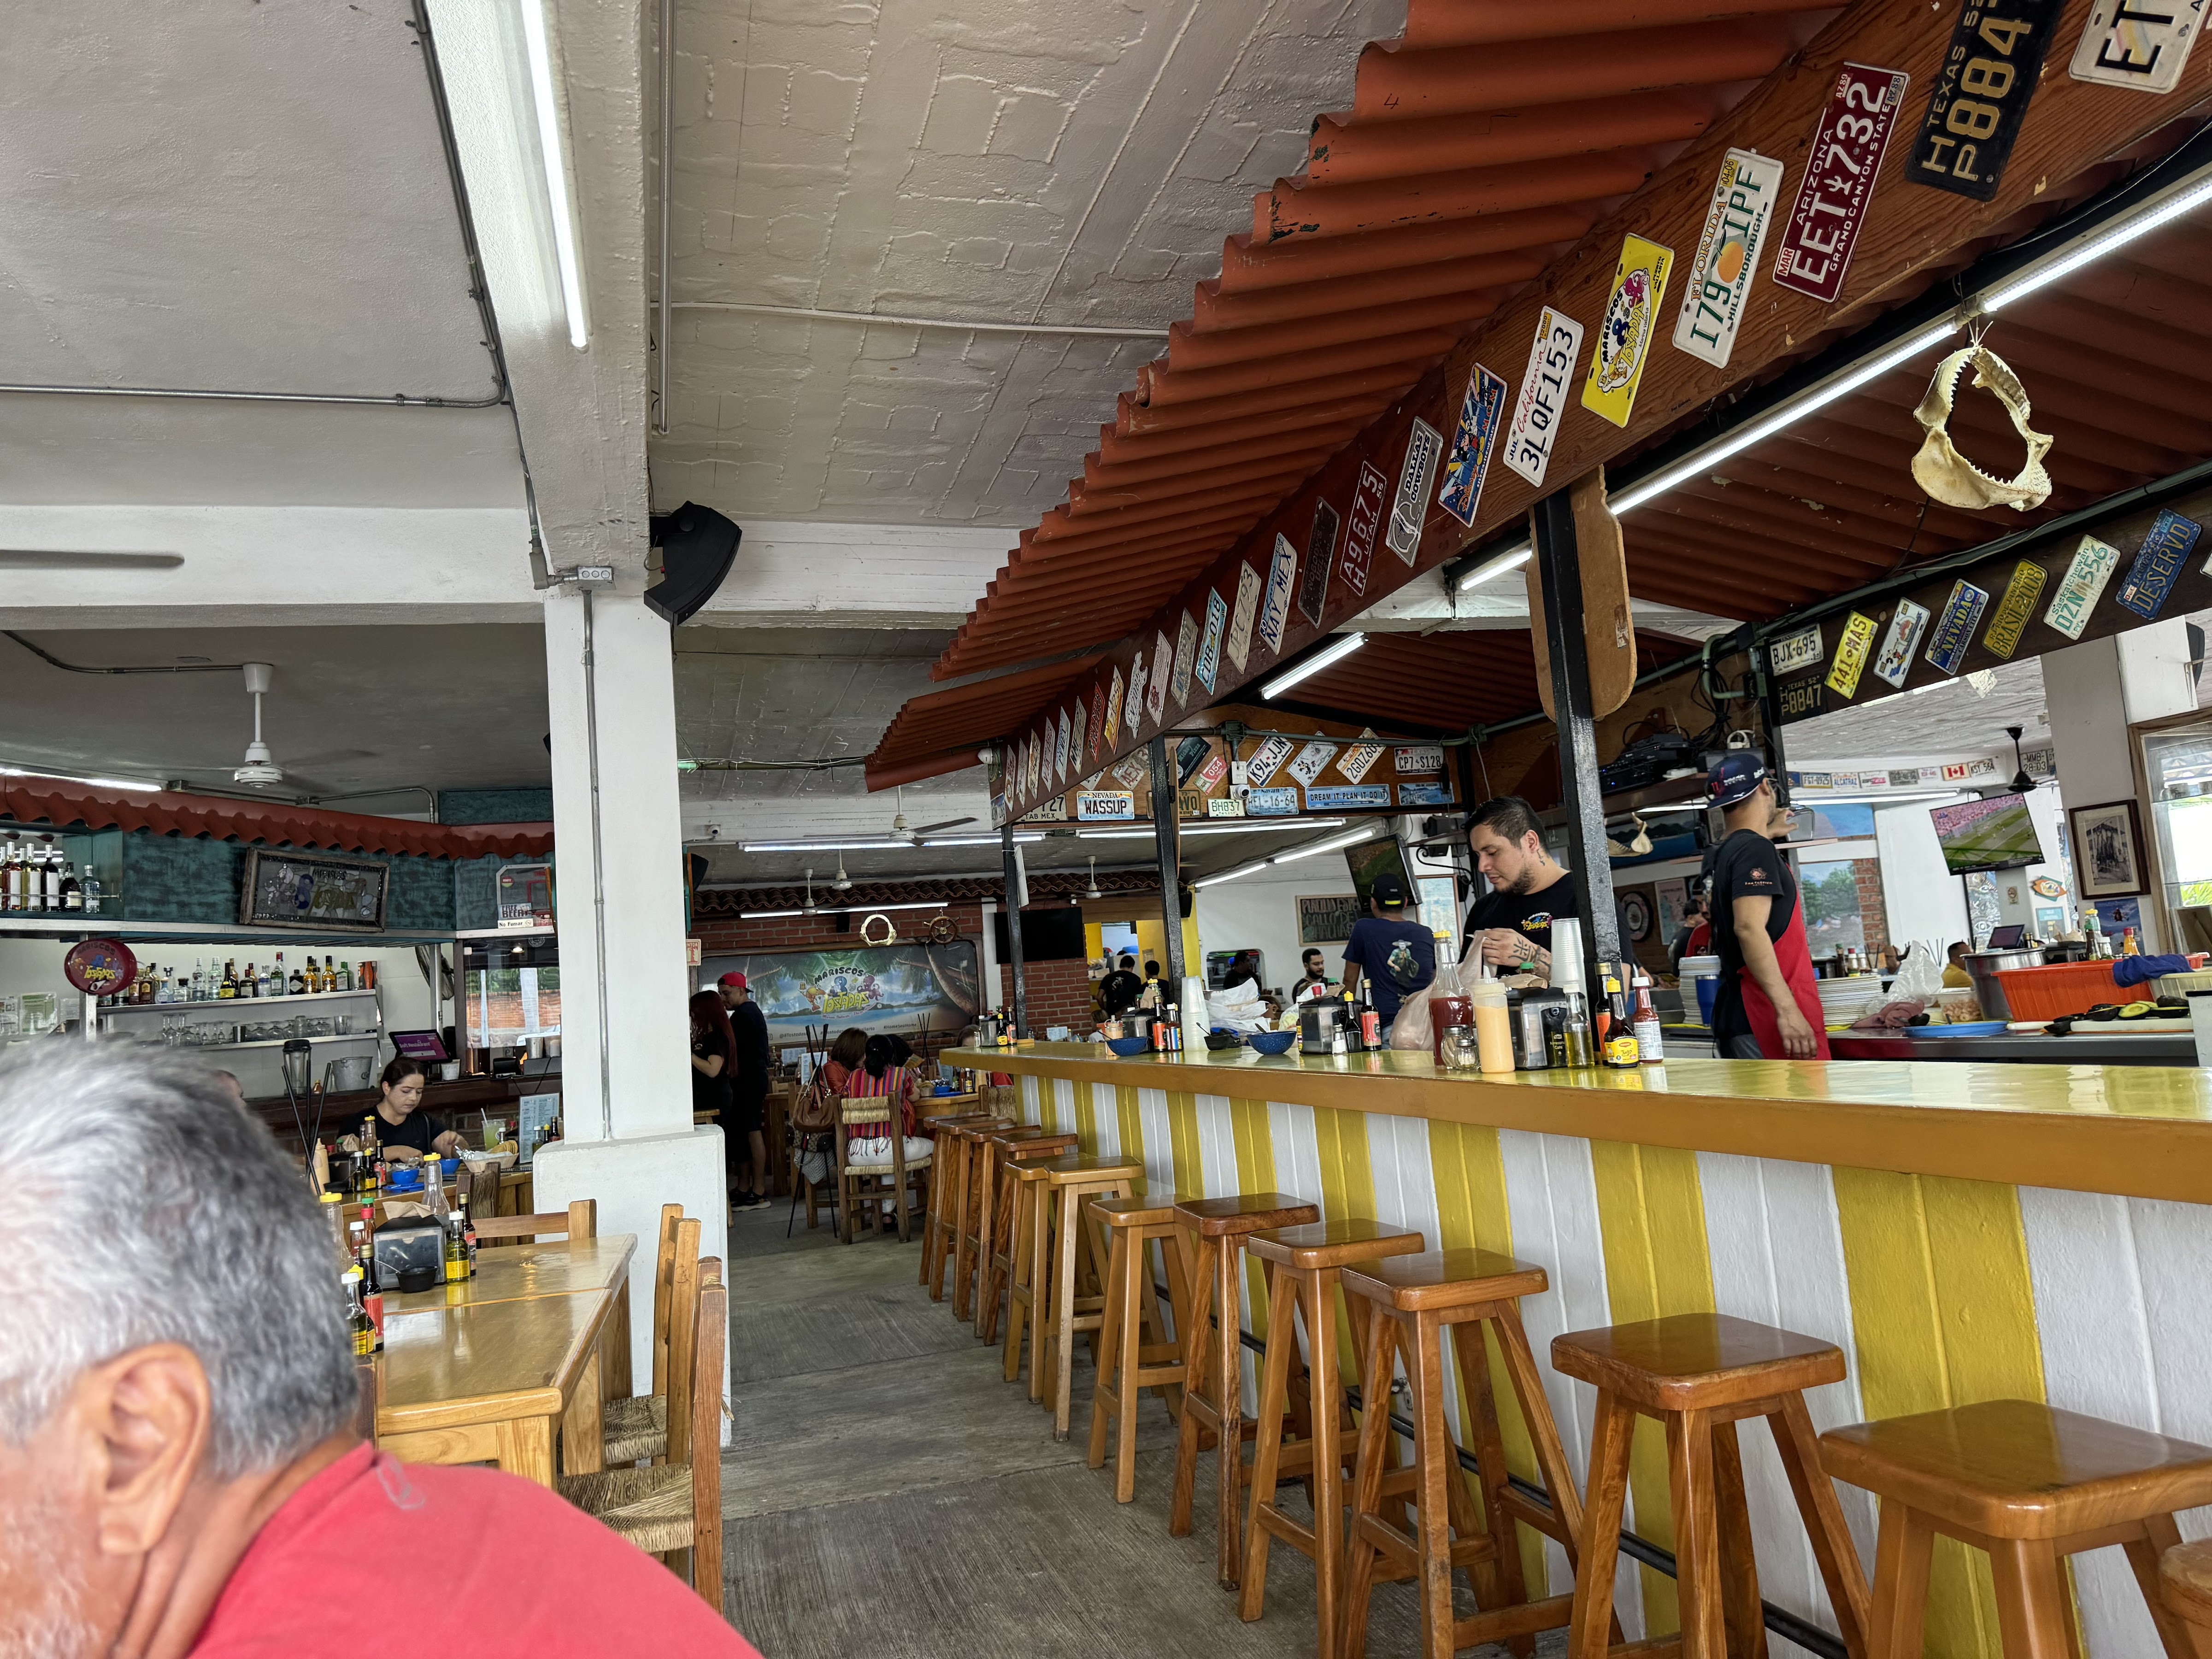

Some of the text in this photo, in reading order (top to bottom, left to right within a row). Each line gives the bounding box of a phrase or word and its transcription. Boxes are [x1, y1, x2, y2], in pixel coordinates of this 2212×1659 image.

[1926, 44, 1967, 130] TEXAS
[1789, 79, 1888, 284] EET 732
[1795, 127, 1834, 225] ARIZONA
[1829, 103, 1891, 272] GRAND CANYON STATE
[1653, 255, 1662, 281] PUERTO
[1653, 257, 1665, 289] VALLARTA
[1689, 166, 1767, 349] I79 IPF
[1690, 199, 1728, 302] FLORIDA
[1726, 212, 1765, 322] HILLSBOROUGH
[1778, 249, 1793, 275] MAR
[1596, 288, 1627, 363] MARISCOS
[1608, 316, 1630, 347] 8
[1617, 296, 1650, 369] TOSTADAS
[1637, 306, 1652, 347] Marina Vallarta
[1514, 337, 1550, 435] California
[1519, 324, 1575, 473] 3LQF153
[1405, 432, 1423, 492] DALLAS
[1410, 433, 1431, 502] COWBOYS
[1456, 387, 1497, 518] Disney MGM
[1508, 436, 1518, 461] JUL
[1363, 481, 1383, 555] UTAH 56
[2052, 546, 2089, 615] Saskatchewan
[2054, 541, 2109, 631] DZN 556
[2124, 585, 2136, 600] DEC
[2133, 522, 2194, 611] DESERVD
[1266, 599, 1282, 646] NAY
[1276, 546, 1292, 594] MEX
[1968, 614, 1977, 629] CITY
[1260, 618, 1267, 635] JO
[1831, 616, 1868, 690] 441 MAS
[1941, 598, 1973, 654] NEVADA
[1788, 681, 1805, 690] TEXAS
[1788, 684, 1821, 714] 8847
[1209, 760, 1223, 776] 054
[1250, 758, 1271, 782] K94
[1399, 755, 1442, 769] CP7 S128
[1085, 800, 1127, 814] WASSUP
[1212, 801, 1240, 812] BH837
[502, 909, 524, 918] BEER
[814, 966, 865, 984] MARISCOS
[822, 991, 870, 1013] TOSTADAS
